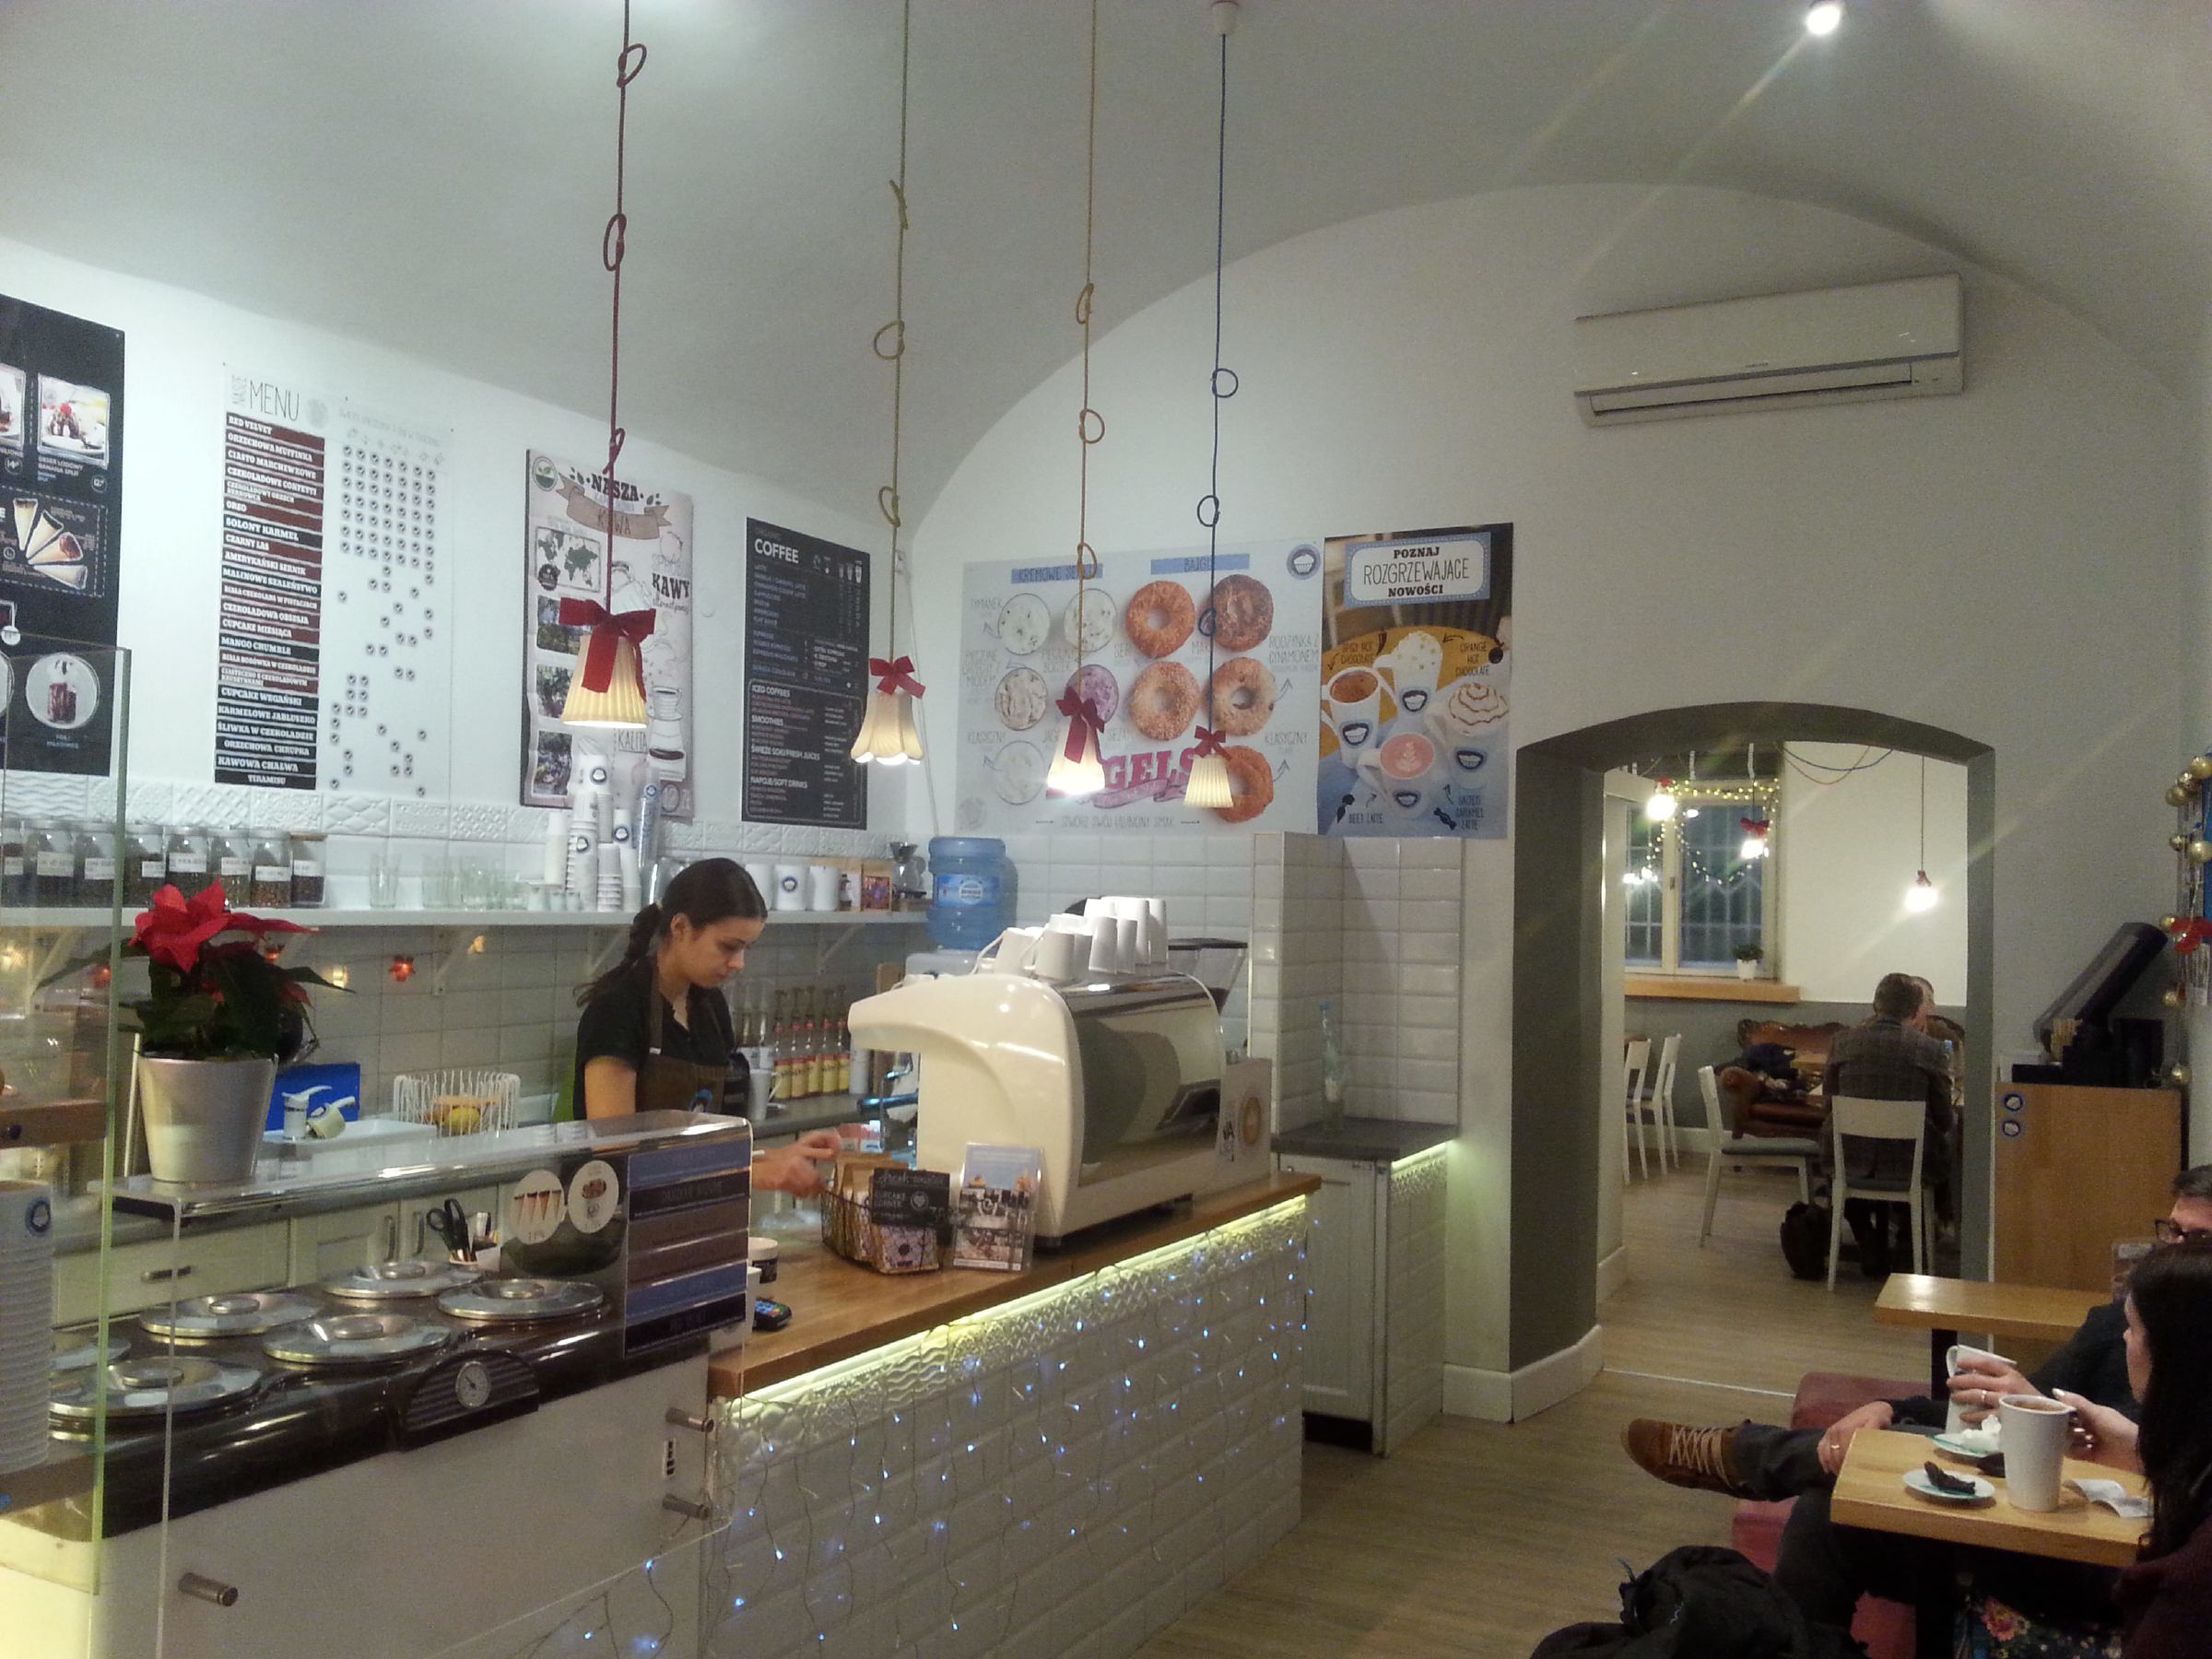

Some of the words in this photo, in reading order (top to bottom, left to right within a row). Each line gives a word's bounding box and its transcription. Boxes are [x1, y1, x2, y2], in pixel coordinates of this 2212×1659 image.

[250, 379, 300, 421] MENU
[229, 416, 244, 428] RED
[244, 420, 272, 435] VELVET
[228, 449, 255, 464] CIASTO
[591, 473, 640, 501] NASZA
[226, 500, 247, 512] OREO
[226, 517, 261, 533] SOLONY
[262, 525, 300, 542] KARMEL
[597, 508, 632, 535] KWA
[226, 535, 256, 547] CZARNY
[256, 541, 269, 551] LAS
[754, 538, 799, 564] COFFEE
[1394, 547, 1441, 559] POZNAJ
[223, 567, 267, 584] MALINOWE
[1363, 558, 1470, 586] ROZGRZEWAJĄCE
[652, 572, 690, 600] KAWY
[1388, 583, 1443, 597] NOWOŚCI
[222, 618, 256, 632] CUPCAKE
[221, 637, 252, 650] MANGO
[253, 642, 291, 655] CRUMBLE
[221, 687, 258, 700] CUPCAKE
[259, 692, 302, 707] WEGAŃSKI
[218, 705, 271, 719] KARMELOWE
[251, 726, 260, 735] W
[224, 739, 273, 753] ORZECHOWA
[218, 756, 261, 770] KAWOWA
[247, 774, 286, 784] TIRAMISU
